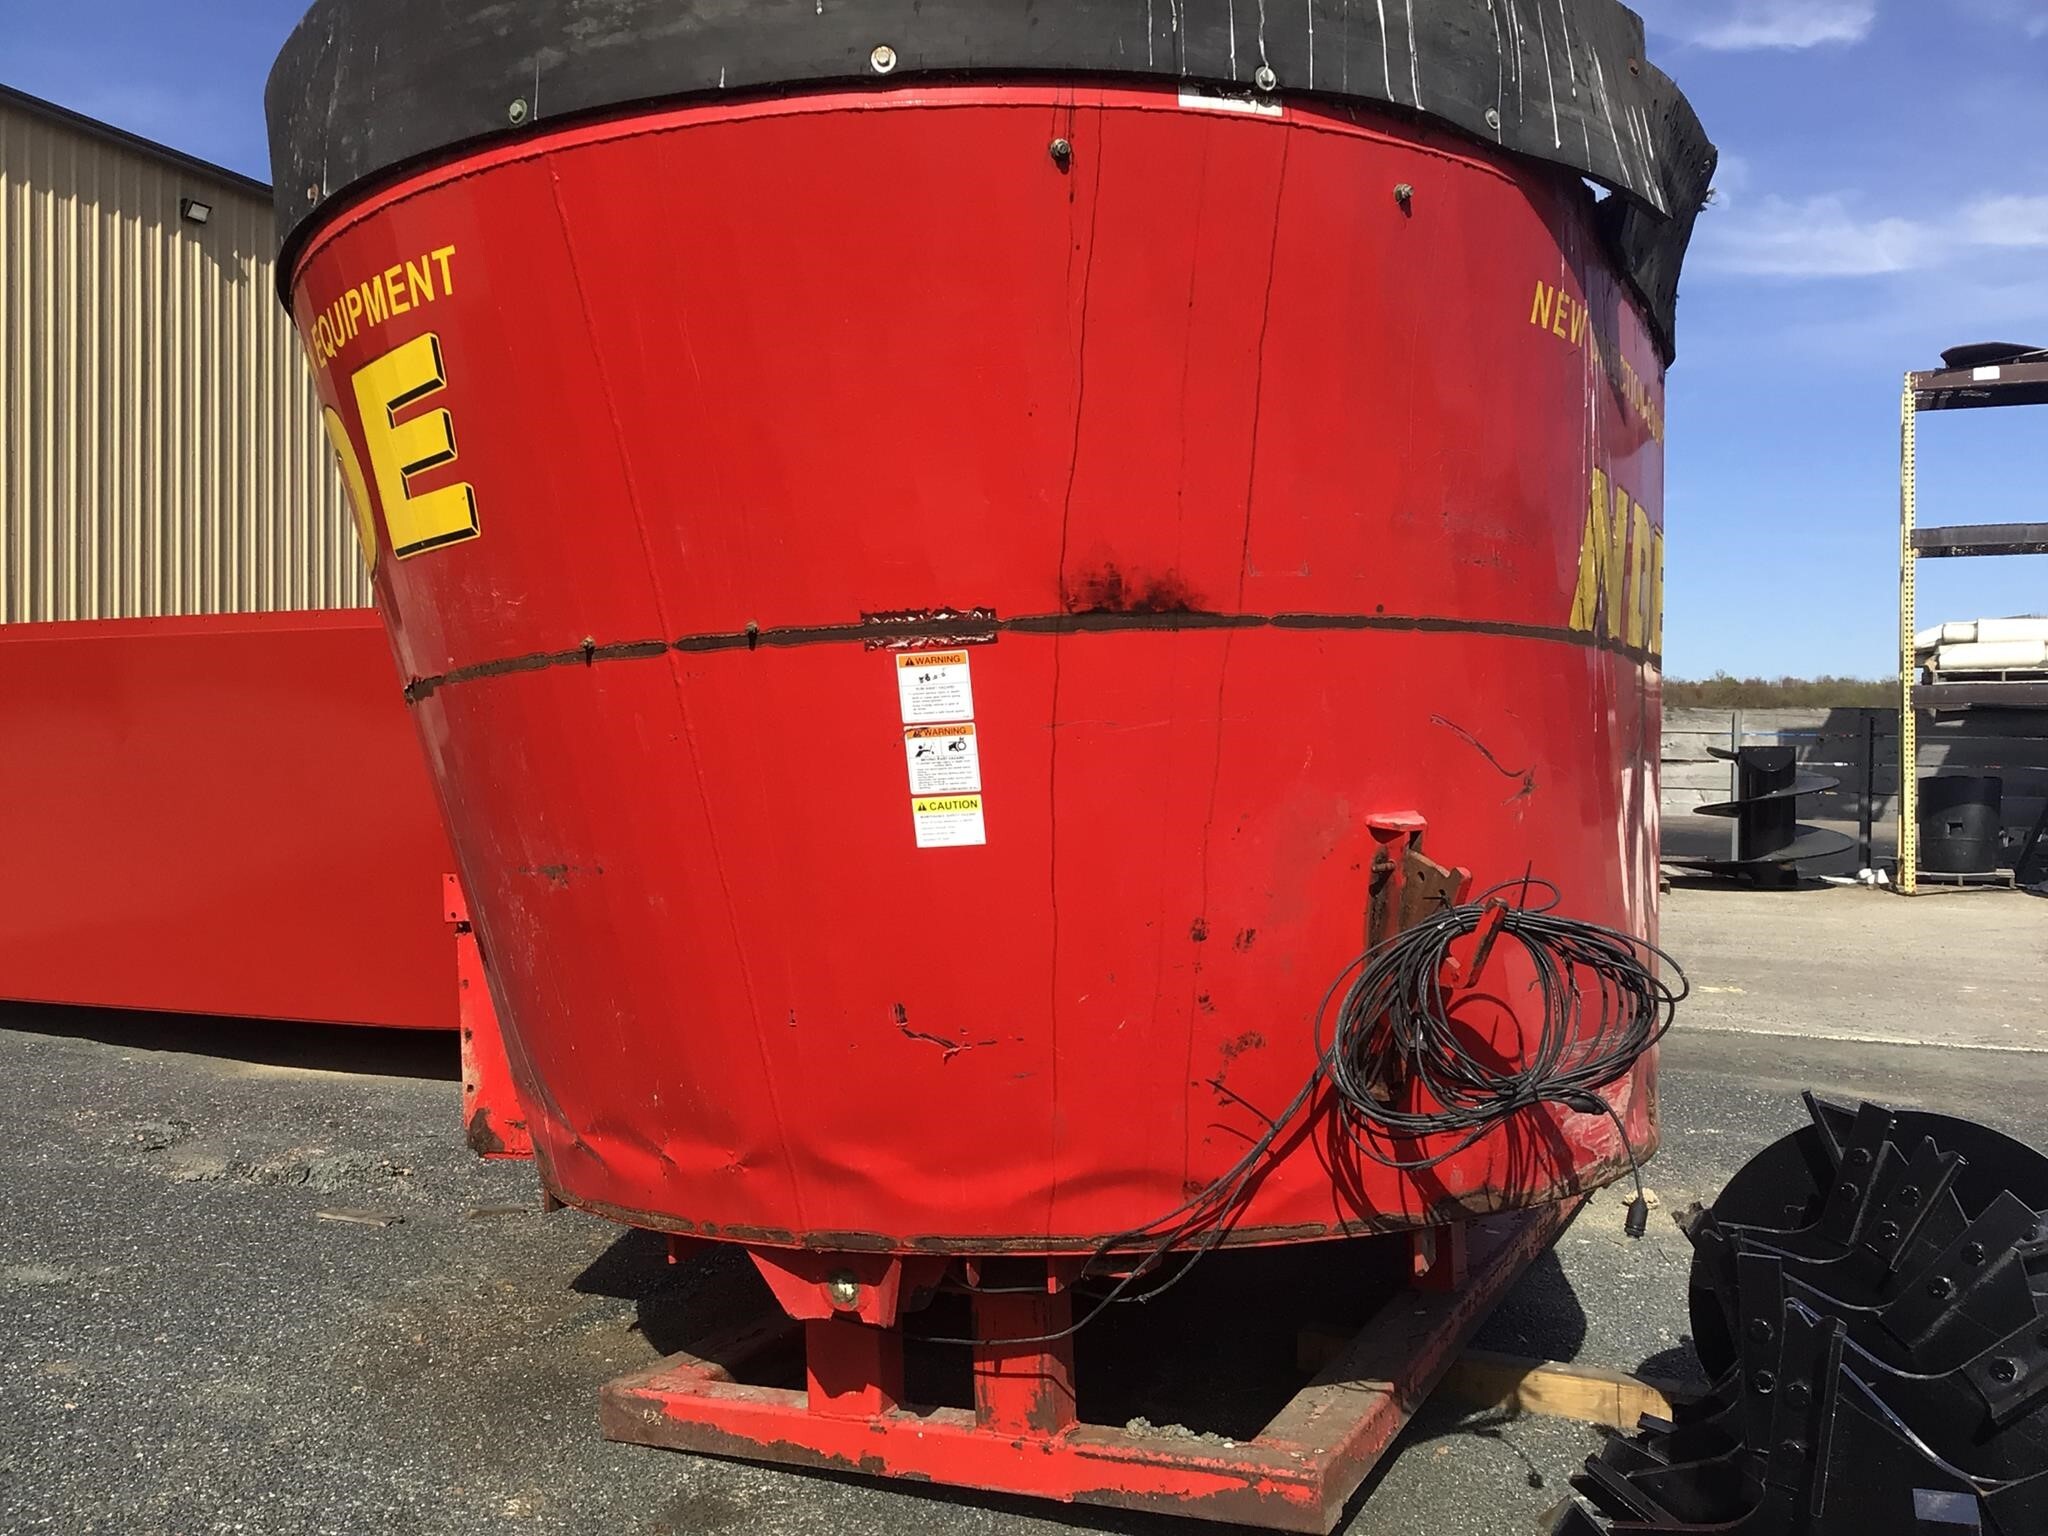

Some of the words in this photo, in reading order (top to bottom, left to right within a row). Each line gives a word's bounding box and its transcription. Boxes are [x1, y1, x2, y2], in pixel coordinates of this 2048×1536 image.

[310, 244, 456, 369] EQUIPMENT
[1530, 280, 1588, 348] NEW
[914, 654, 961, 665] WARNING
[923, 726, 967, 737] WARNING
[929, 800, 978, 811] CAUTION
